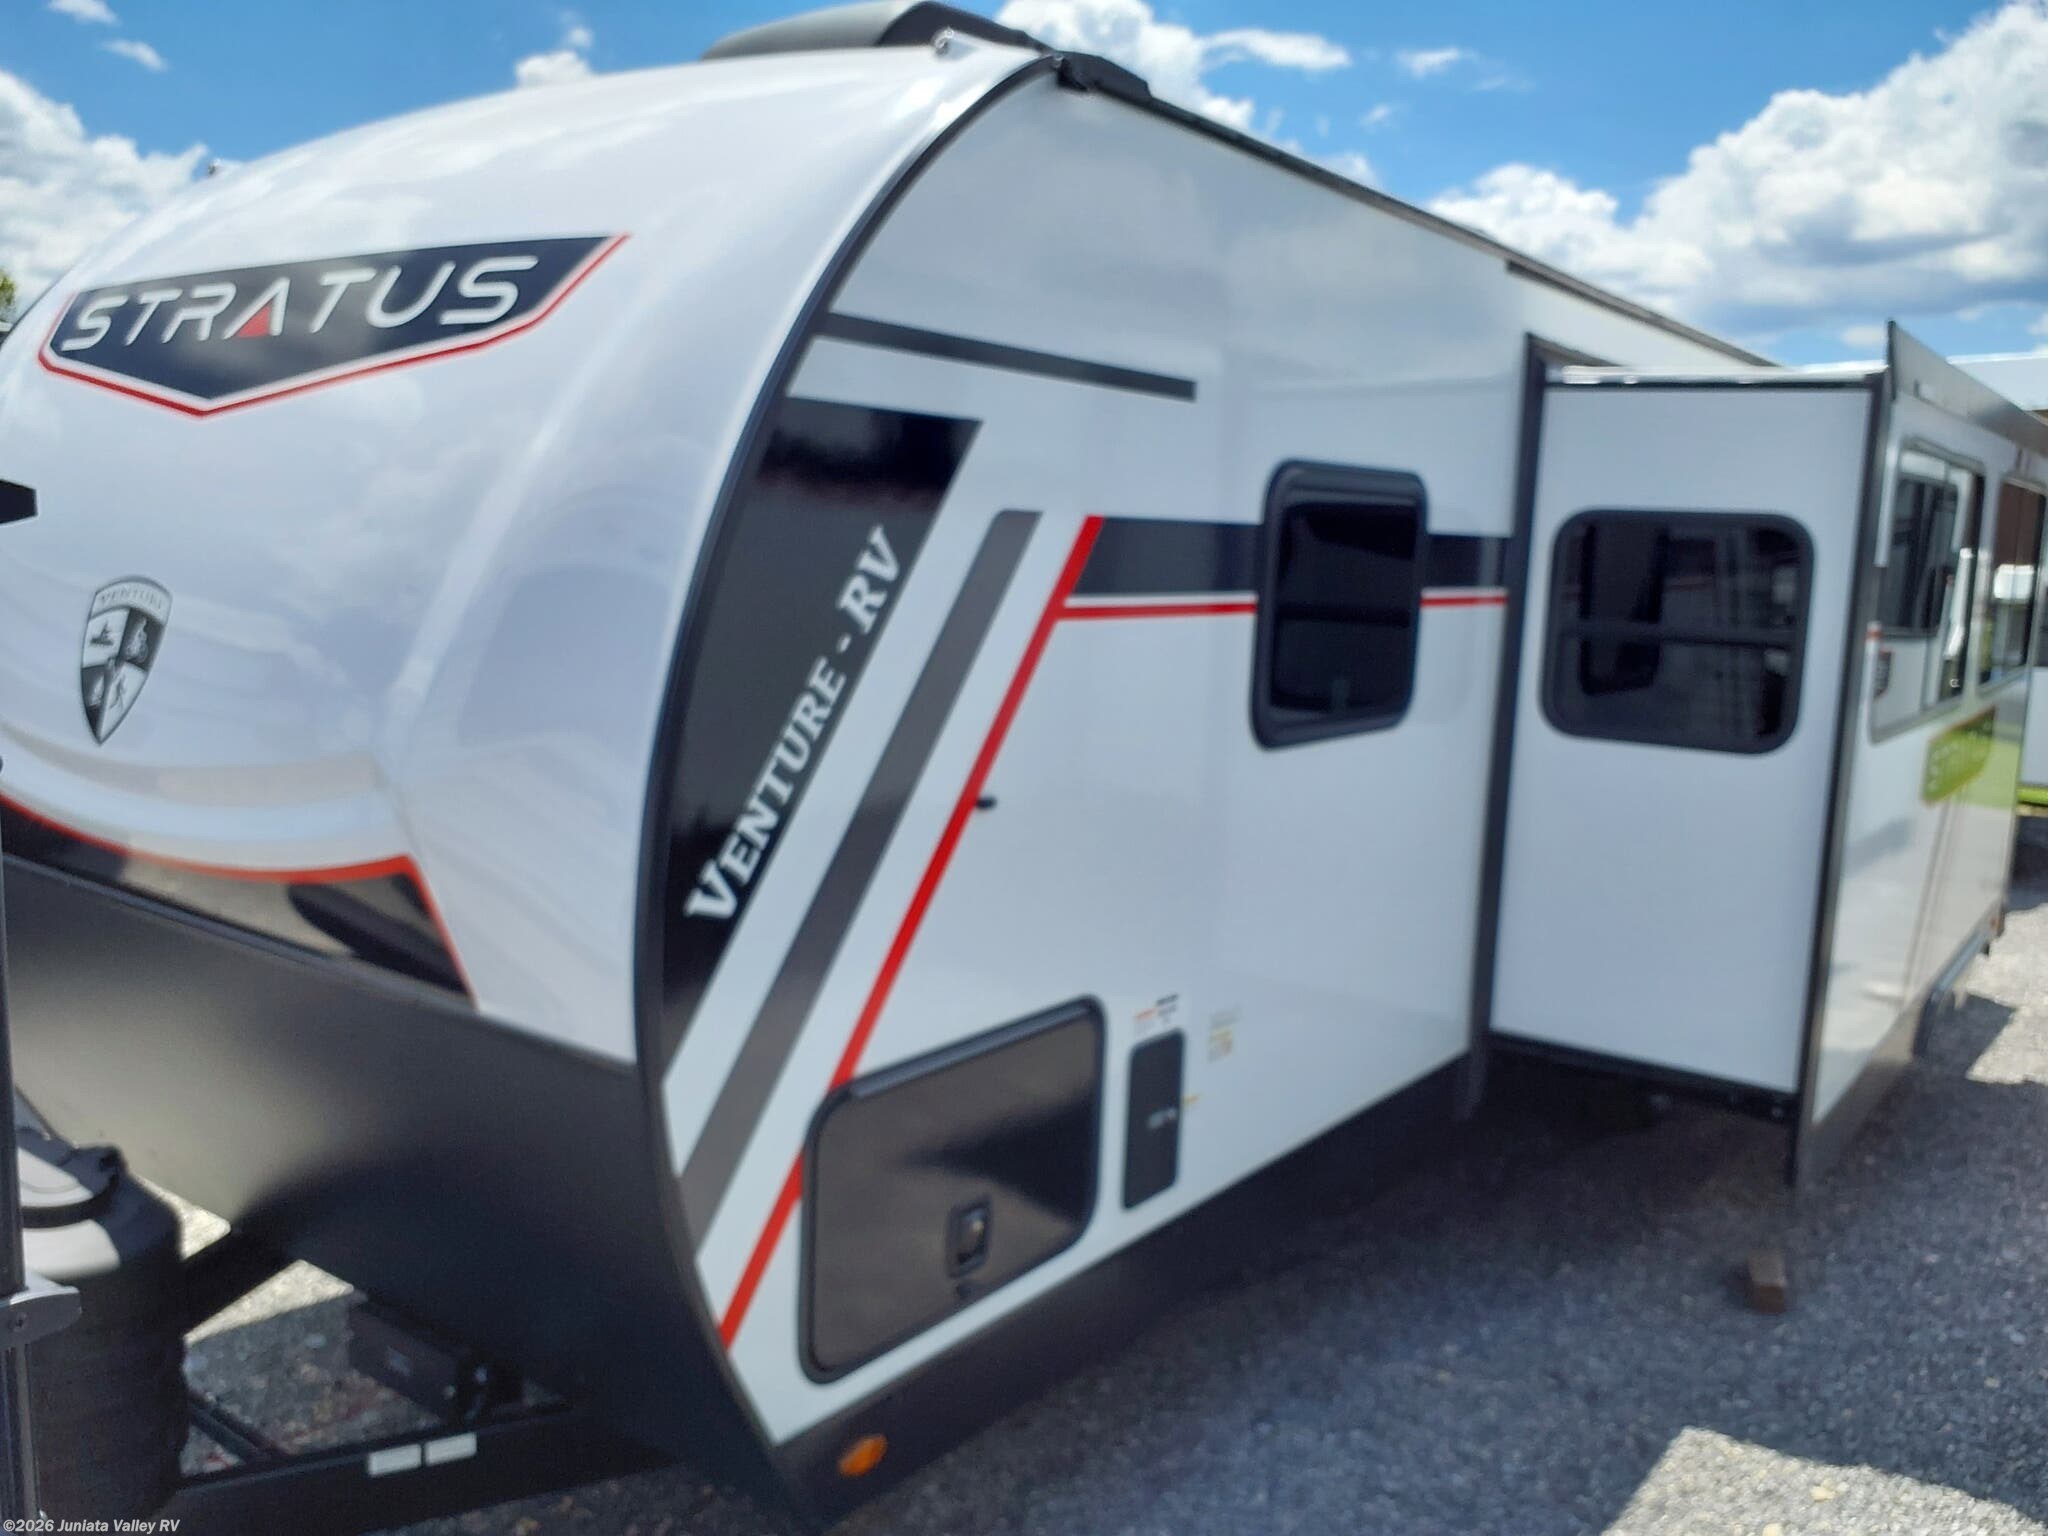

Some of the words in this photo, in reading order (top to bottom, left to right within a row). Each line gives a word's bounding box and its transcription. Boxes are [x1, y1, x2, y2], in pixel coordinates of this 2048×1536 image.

[61, 255, 538, 351] STRATUS
[684, 656, 847, 921] VENTURE
[836, 524, 901, 636] RV
